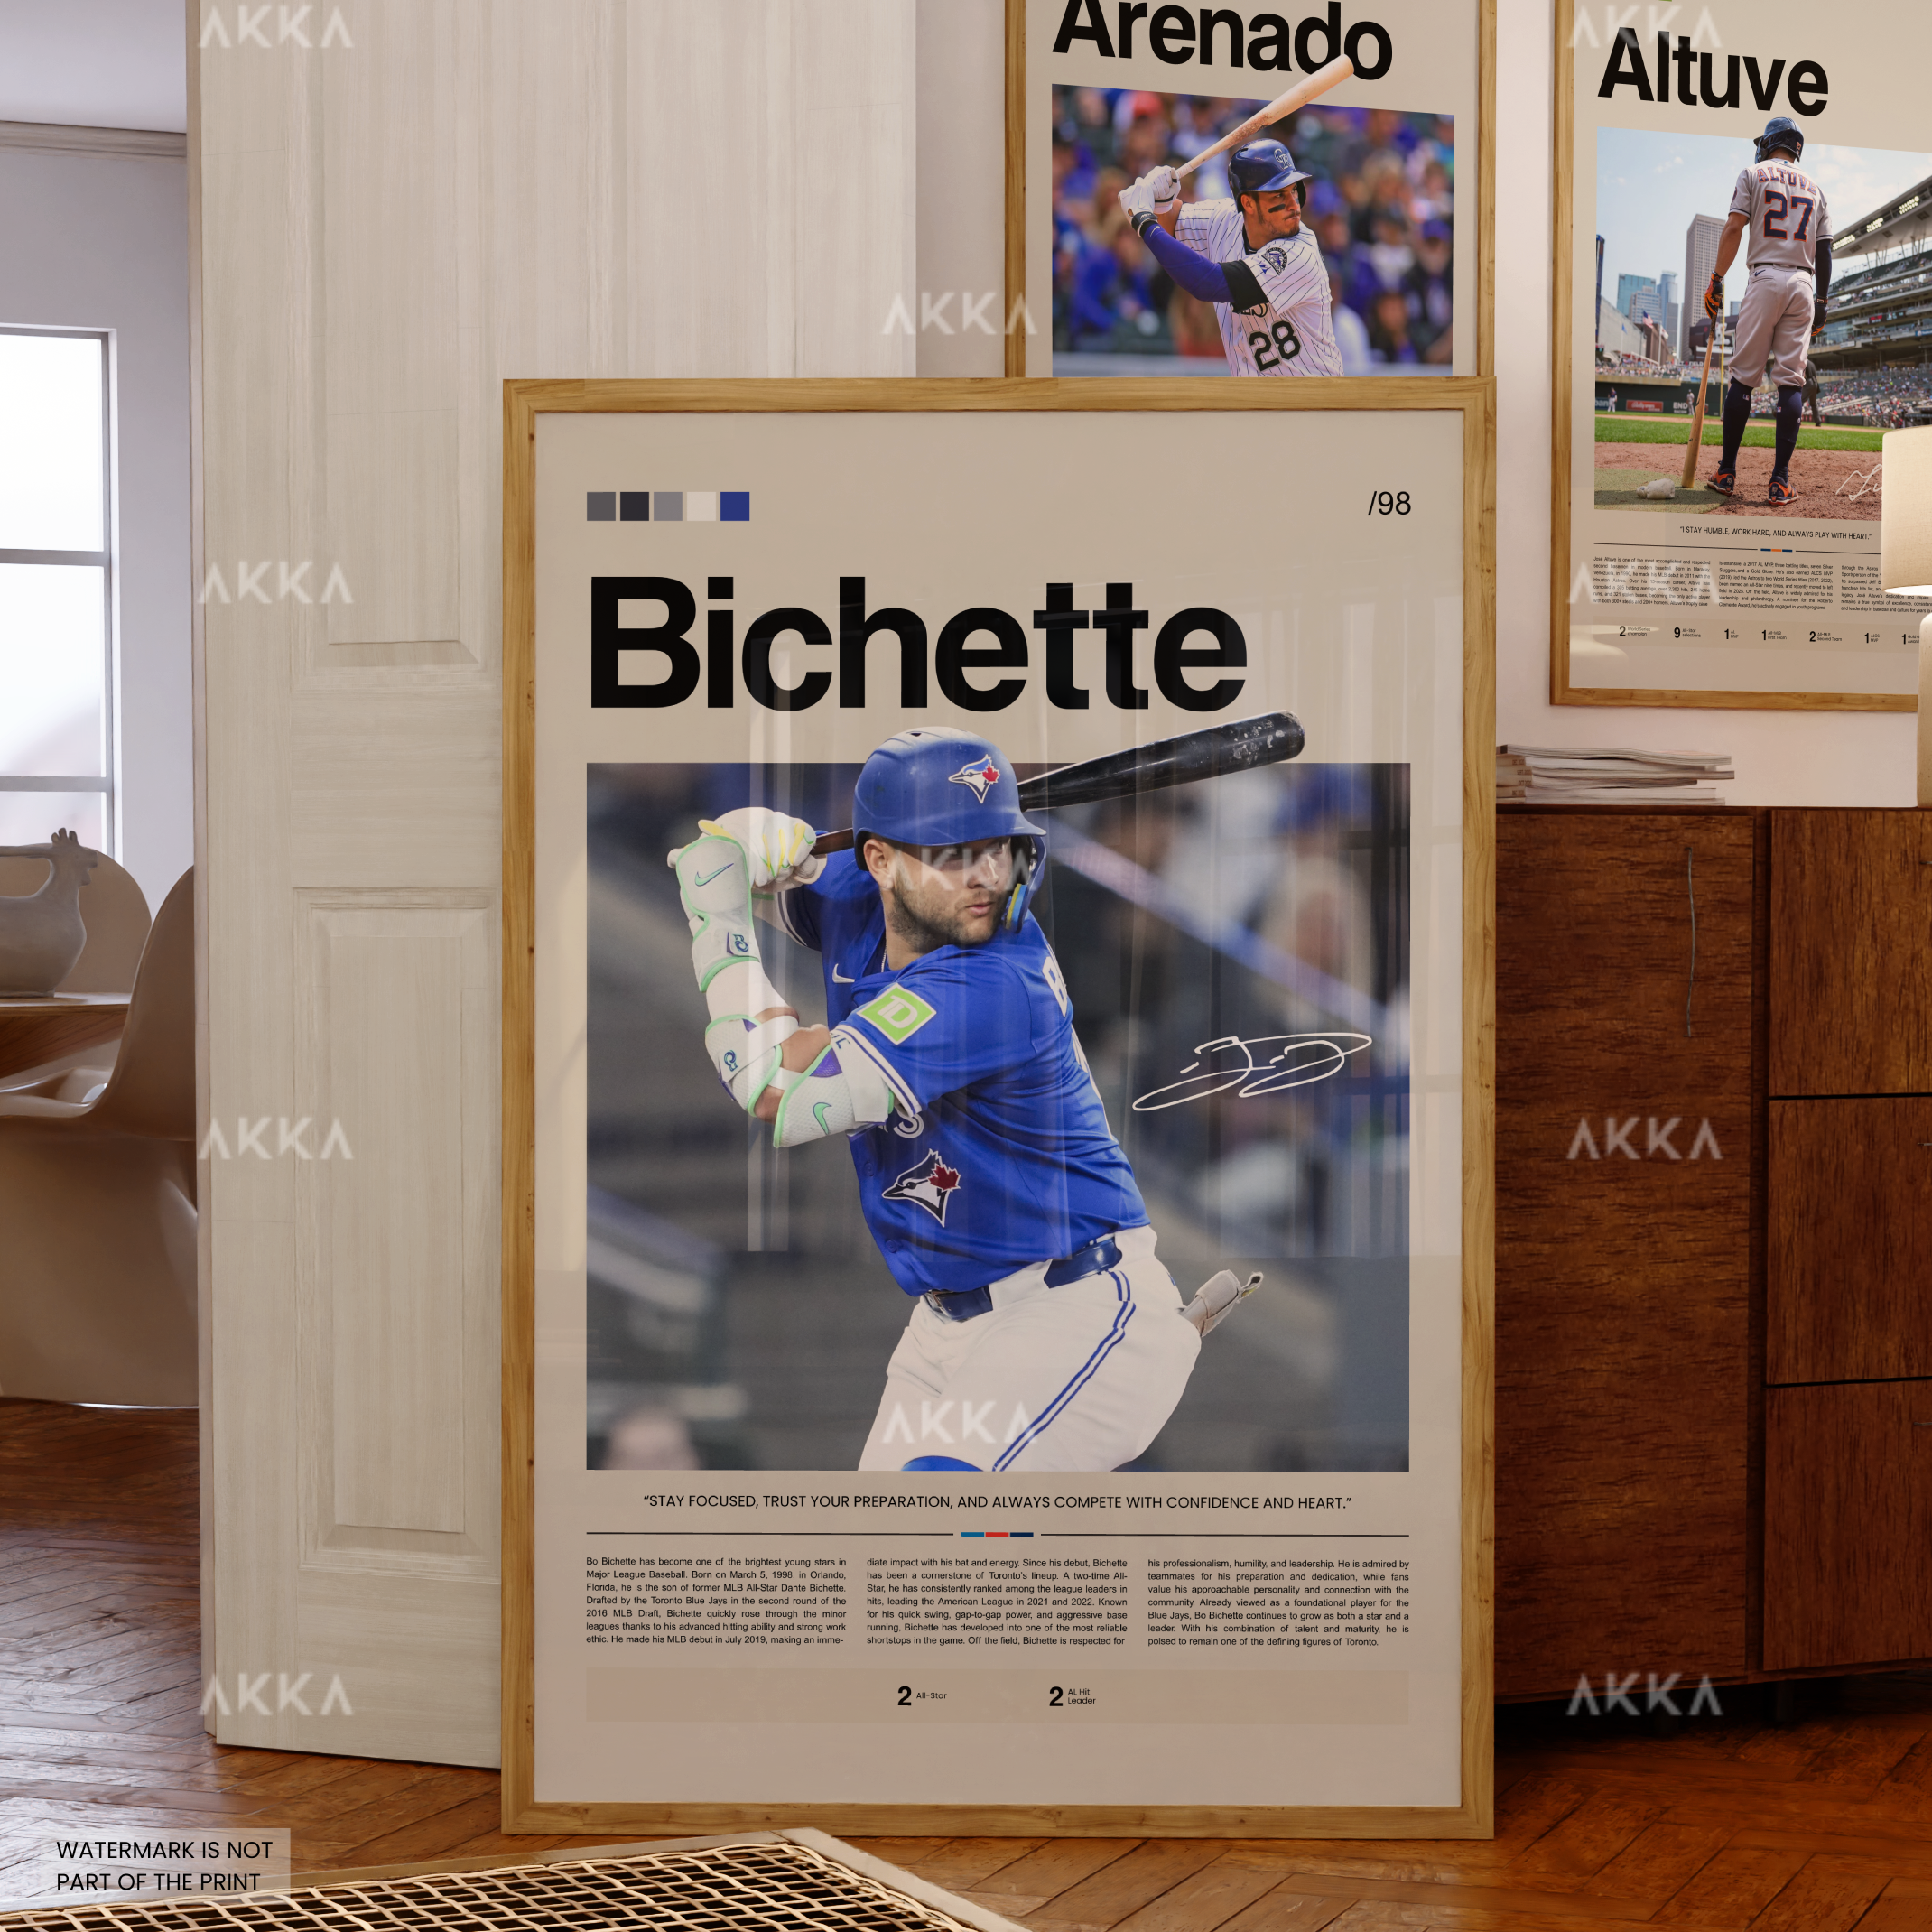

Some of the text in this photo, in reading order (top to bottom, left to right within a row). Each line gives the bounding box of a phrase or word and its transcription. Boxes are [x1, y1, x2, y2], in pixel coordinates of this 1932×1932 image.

[1053, 0, 1392, 80] Arenado
[1597, 27, 1828, 116] Altuve
[1757, 167, 1816, 195] ALTUVE
[1764, 190, 1814, 242] 27
[1249, 320, 1301, 372] 28
[1368, 491, 1411, 516] /98
[1704, 527, 1730, 535] HUMBLE,
[1752, 529, 1771, 537] HARD,
[1620, 626, 1626, 637] 2
[1674, 627, 1680, 638] 9
[1723, 628, 1729, 639] 1
[1761, 630, 1766, 640] 1
[1809, 631, 1816, 642] 2
[1864, 633, 1869, 643] 1
[1901, 634, 1906, 644] 1
[591, 577, 1247, 712] Bichette
[689, 1495, 758, 1509] FOCUSED,
[763, 1496, 806, 1507] TRUST
[811, 1496, 849, 1507] YOUR
[854, 1496, 953, 1509] PREPARATION,
[958, 1496, 988, 1508] AND
[992, 1496, 1050, 1508] ALWAYS
[1054, 1497, 1121, 1508] COMPETE
[1126, 1497, 1162, 1508] WITH
[1166, 1497, 1259, 1509] CONFIDENCE
[1263, 1497, 1294, 1509] AND
[587, 1557, 598, 1565] Bo
[602, 1557, 636, 1565] Bichette
[639, 1557, 655, 1565] has
[659, 1557, 692, 1565] become
[715, 1557, 724, 1565] of
[728, 1557, 741, 1565] the
[745, 1557, 782, 1567] brightest
[587, 1570, 610, 1580] Major
[614, 1570, 646, 1580] League
[799, 1571, 806, 1579] in
[681, 1584, 689, 1592] of
[692, 1584, 720, 1592] former
[724, 1584, 743, 1592] MLB
[746, 1584, 778, 1592] All-Star
[782, 1584, 806, 1592] Dante
[587, 1596, 617, 1604] Drafted
[621, 1596, 630, 1606] by
[634, 1596, 647, 1604] the
[651, 1596, 683, 1604] Toronto
[709, 1597, 728, 1606] Jays
[833, 1597, 846, 1605] the
[586, 1609, 608, 1617] 2016
[613, 1609, 633, 1617] MLB
[707, 1610, 736, 1619] quickly
[766, 1610, 797, 1620] through
[803, 1610, 817, 1618] the
[587, 1622, 619, 1631] leagues
[622, 1622, 650, 1630] thanks
[679, 1622, 720, 1630] advanced
[723, 1622, 748, 1632] hitting
[751, 1622, 776, 1632] ability
[797, 1623, 822, 1632] strong
[611, 1635, 623, 1643] He
[626, 1635, 650, 1643] made
[653, 1635, 664, 1643] his
[667, 1635, 686, 1643] MLB
[725, 1636, 742, 1645] July
[771, 1636, 801, 1646] making
[897, 1686, 912, 1706] 2
[1049, 1686, 1064, 1706] 2
